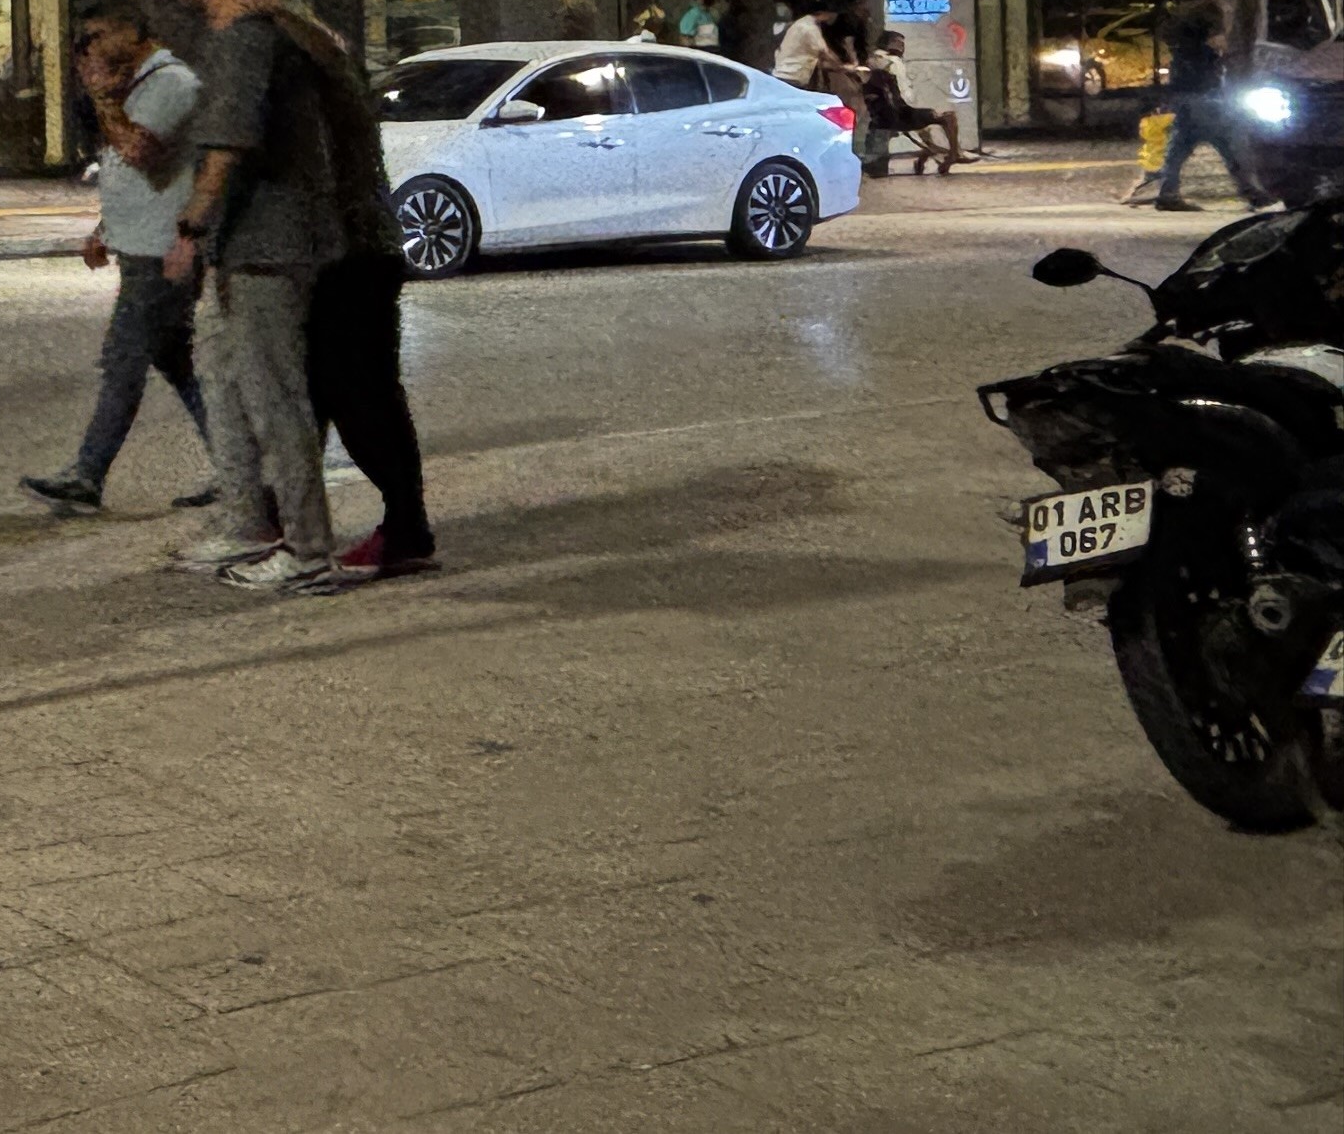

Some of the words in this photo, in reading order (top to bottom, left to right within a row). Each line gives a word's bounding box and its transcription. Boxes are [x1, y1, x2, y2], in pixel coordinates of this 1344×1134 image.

[1033, 500, 1065, 532] 01
[1078, 487, 1146, 524] ARB
[1060, 522, 1117, 557] 067
